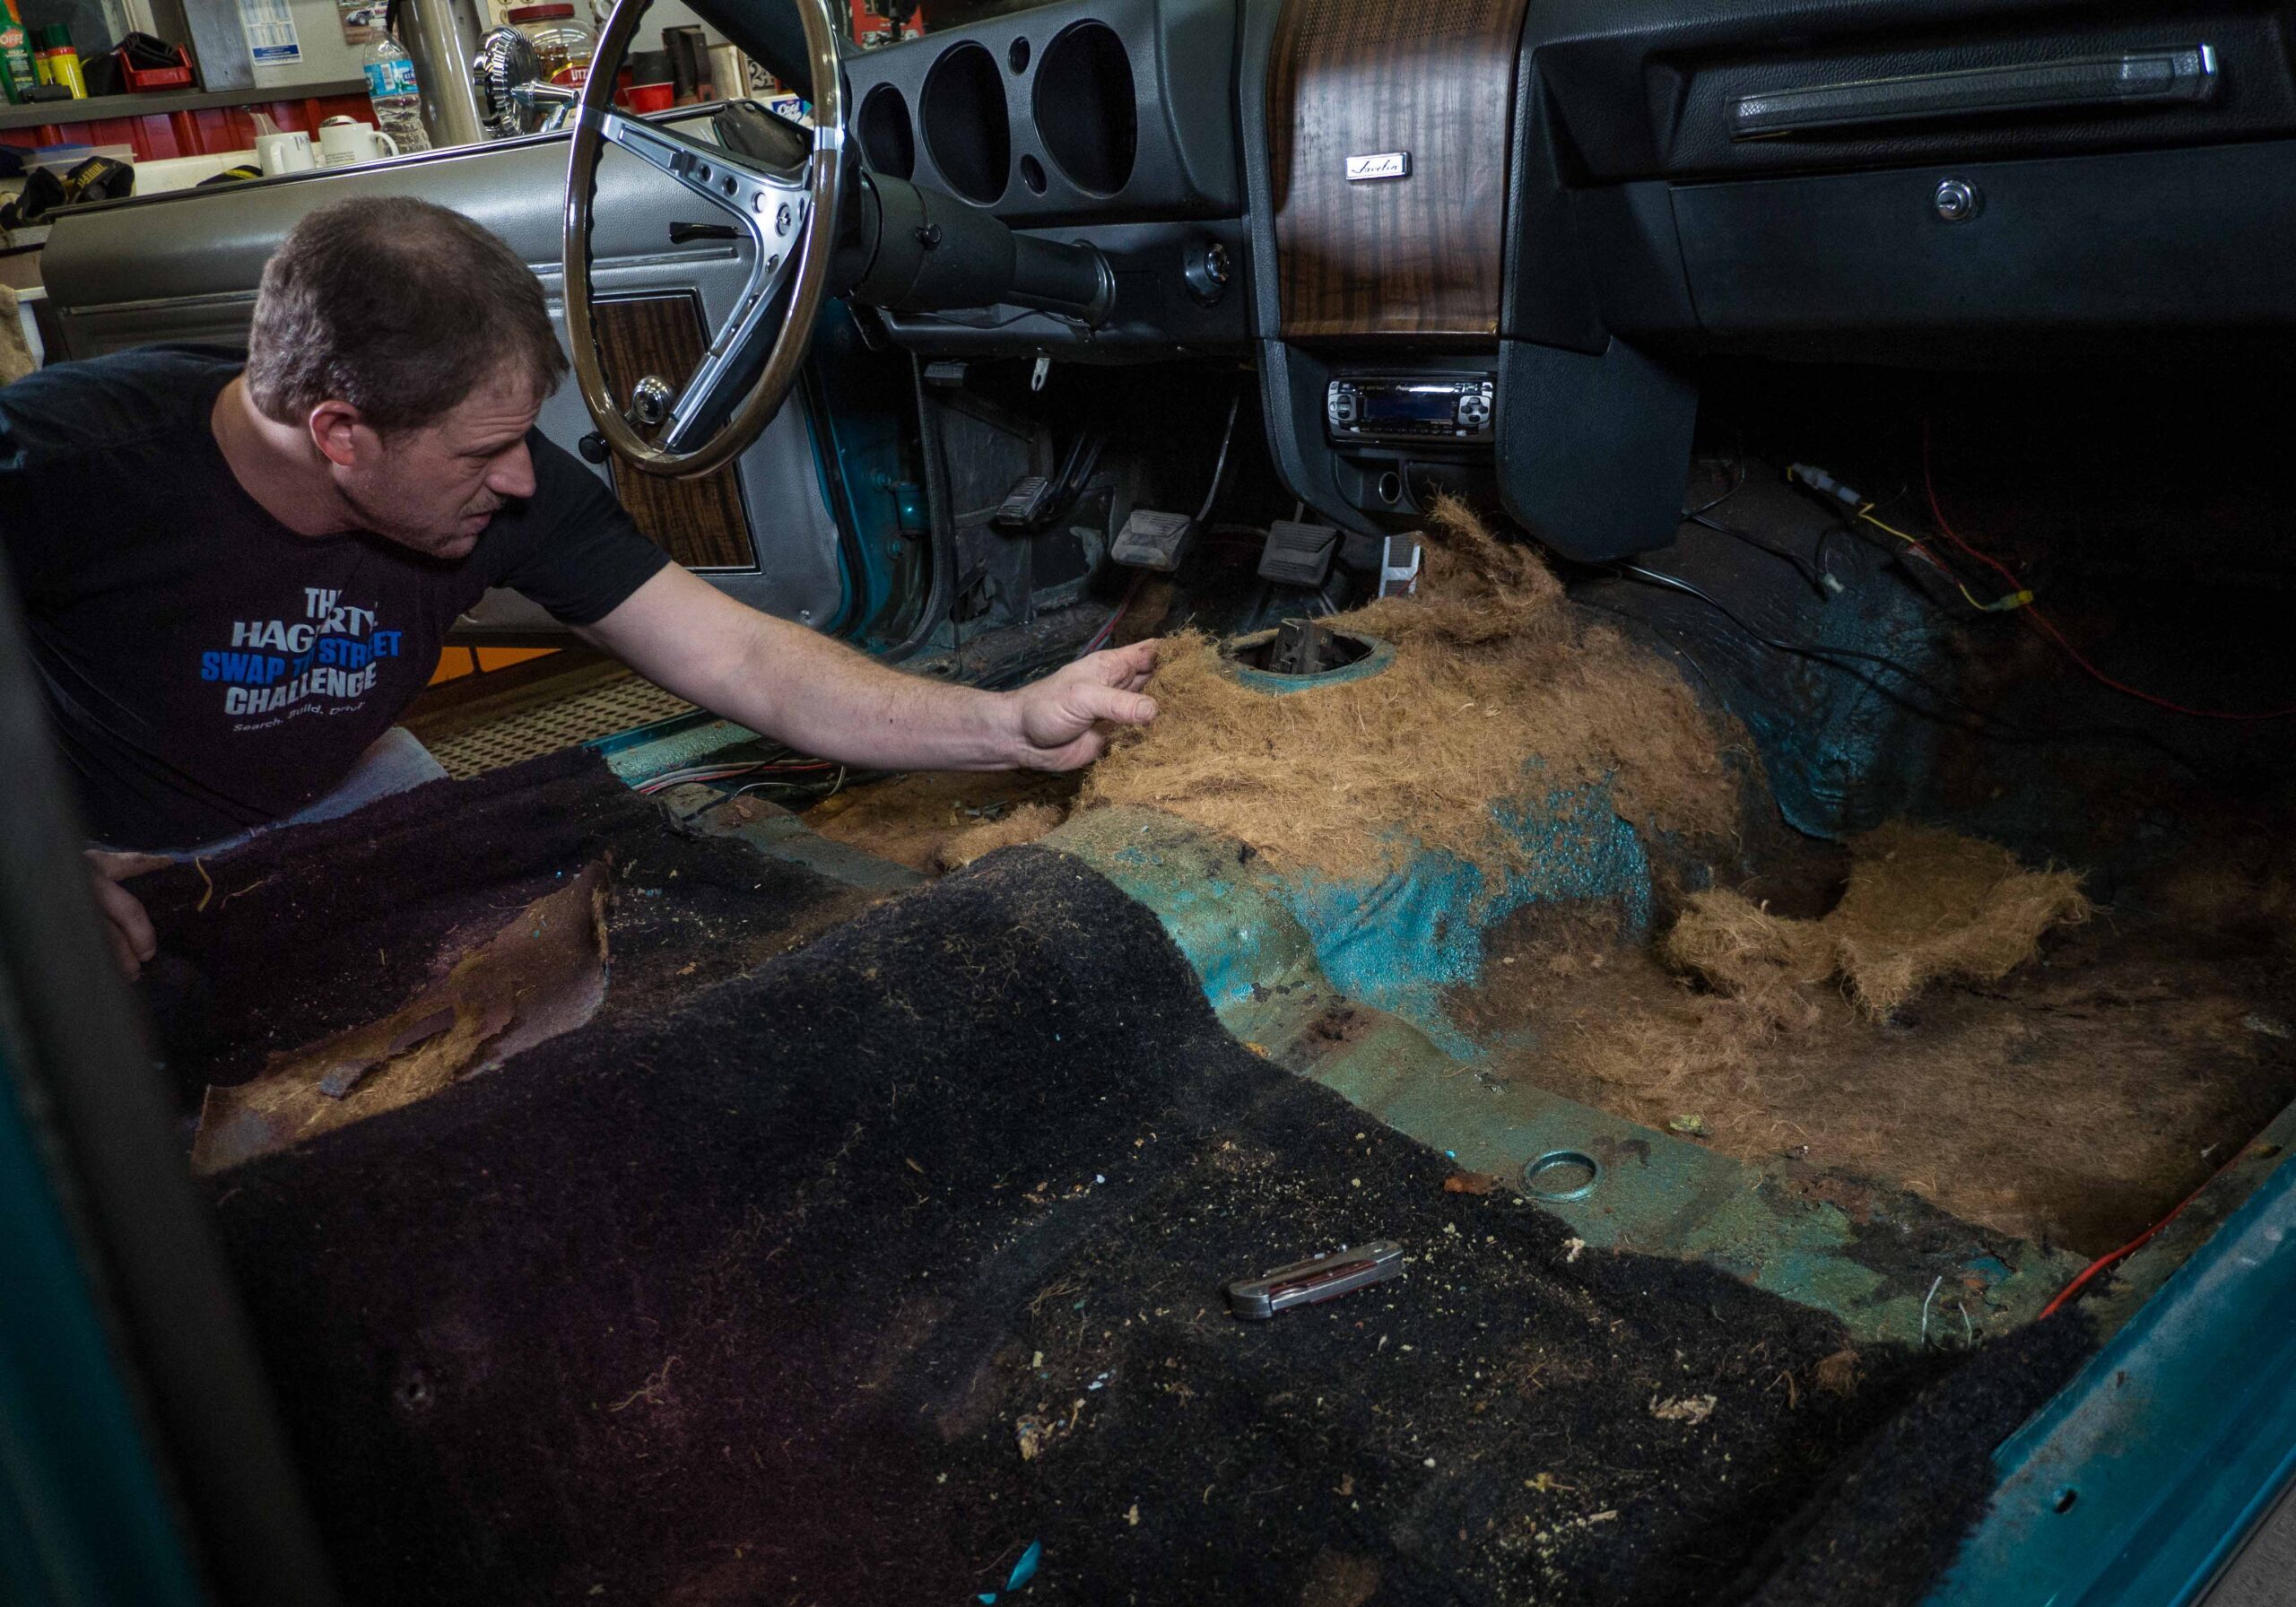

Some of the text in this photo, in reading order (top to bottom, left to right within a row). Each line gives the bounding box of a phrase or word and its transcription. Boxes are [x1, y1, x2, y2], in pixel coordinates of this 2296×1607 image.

[305, 587, 343, 619] TH
[231, 606, 375, 653] HAGRTY
[201, 651, 286, 684] SWAP
[224, 662, 377, 715] CHALLENGE
